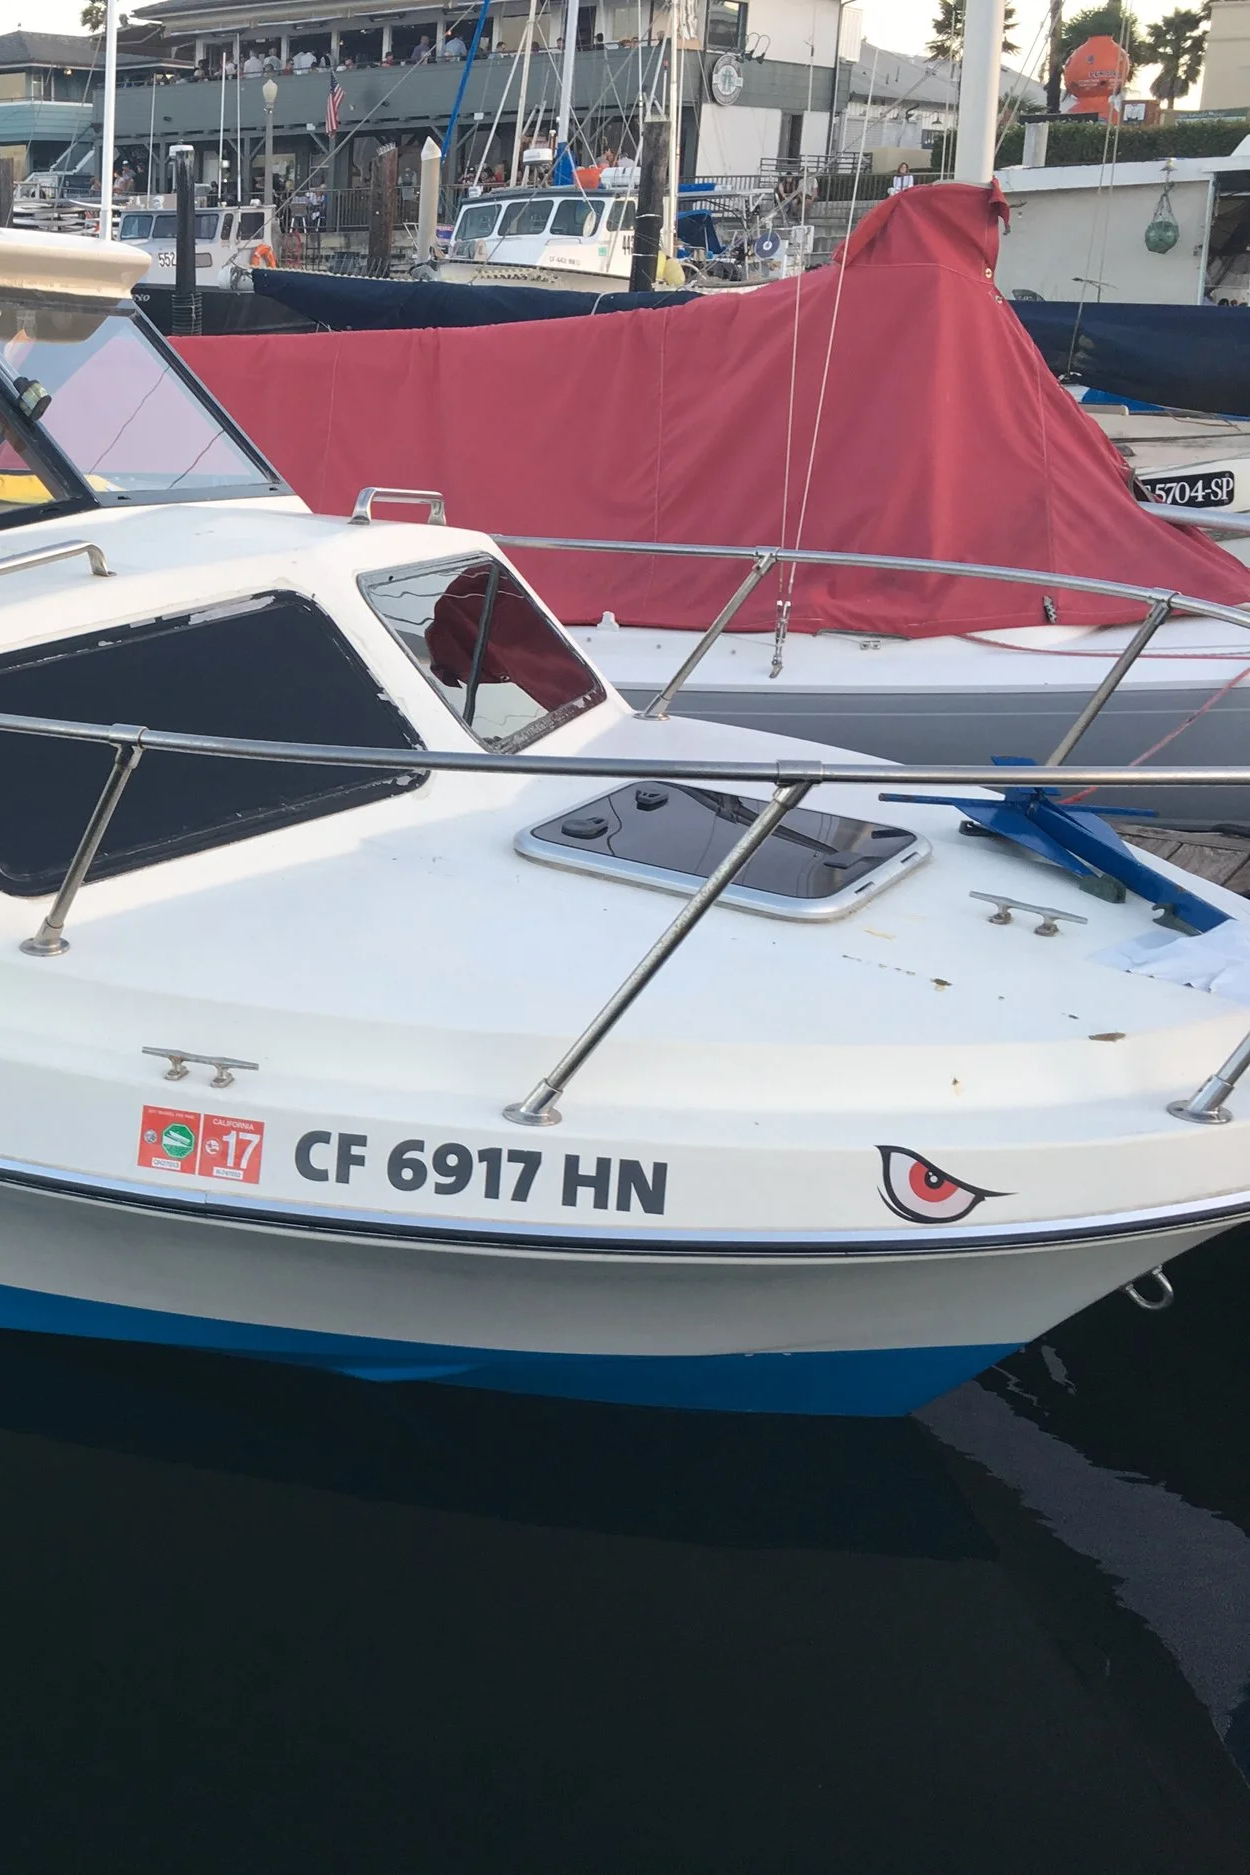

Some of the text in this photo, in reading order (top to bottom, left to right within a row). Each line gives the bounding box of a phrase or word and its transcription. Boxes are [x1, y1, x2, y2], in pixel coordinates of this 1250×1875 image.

[212, 1118, 255, 1131] CALIFORNIA
[222, 1130, 261, 1169] 17
[294, 1130, 668, 1216] CF 6917 HN
